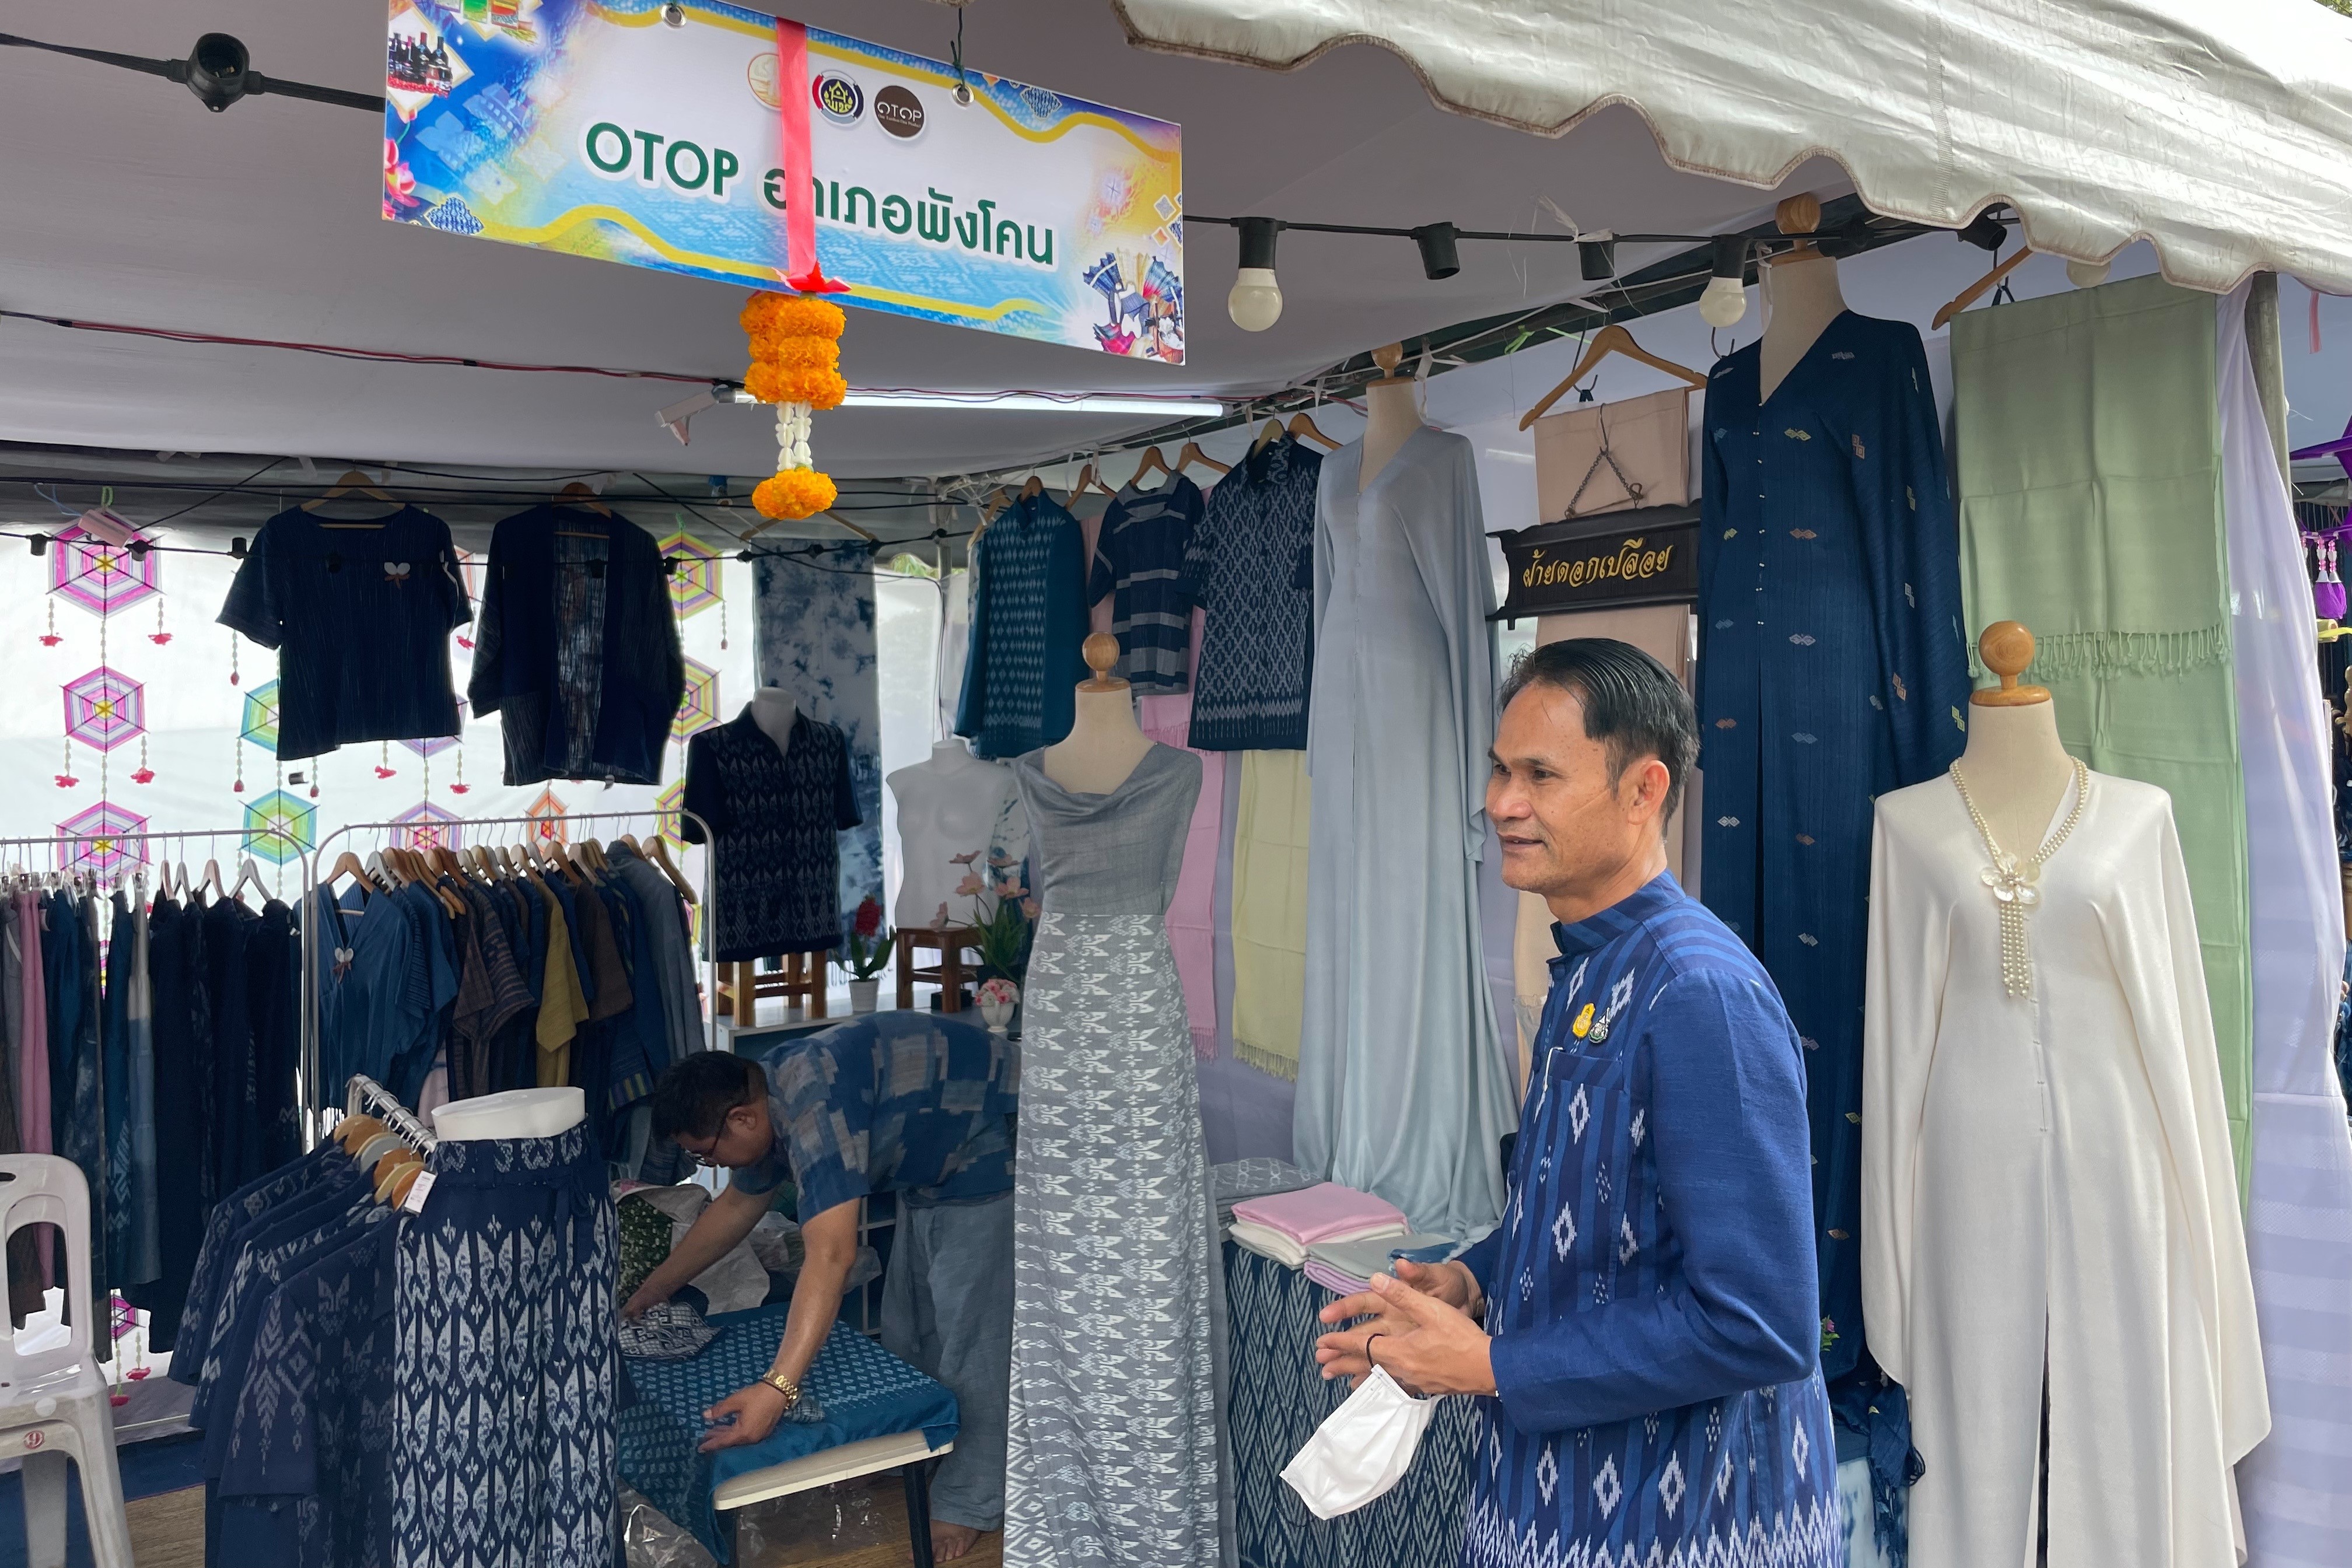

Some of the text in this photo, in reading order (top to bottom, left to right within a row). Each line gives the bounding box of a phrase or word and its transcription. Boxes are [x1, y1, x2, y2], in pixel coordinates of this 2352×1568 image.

[877, 102, 922, 122] OTOP
[586, 122, 739, 197] OTOP
[1522, 537, 1675, 588] ฝ้ายดอกเปลือย
